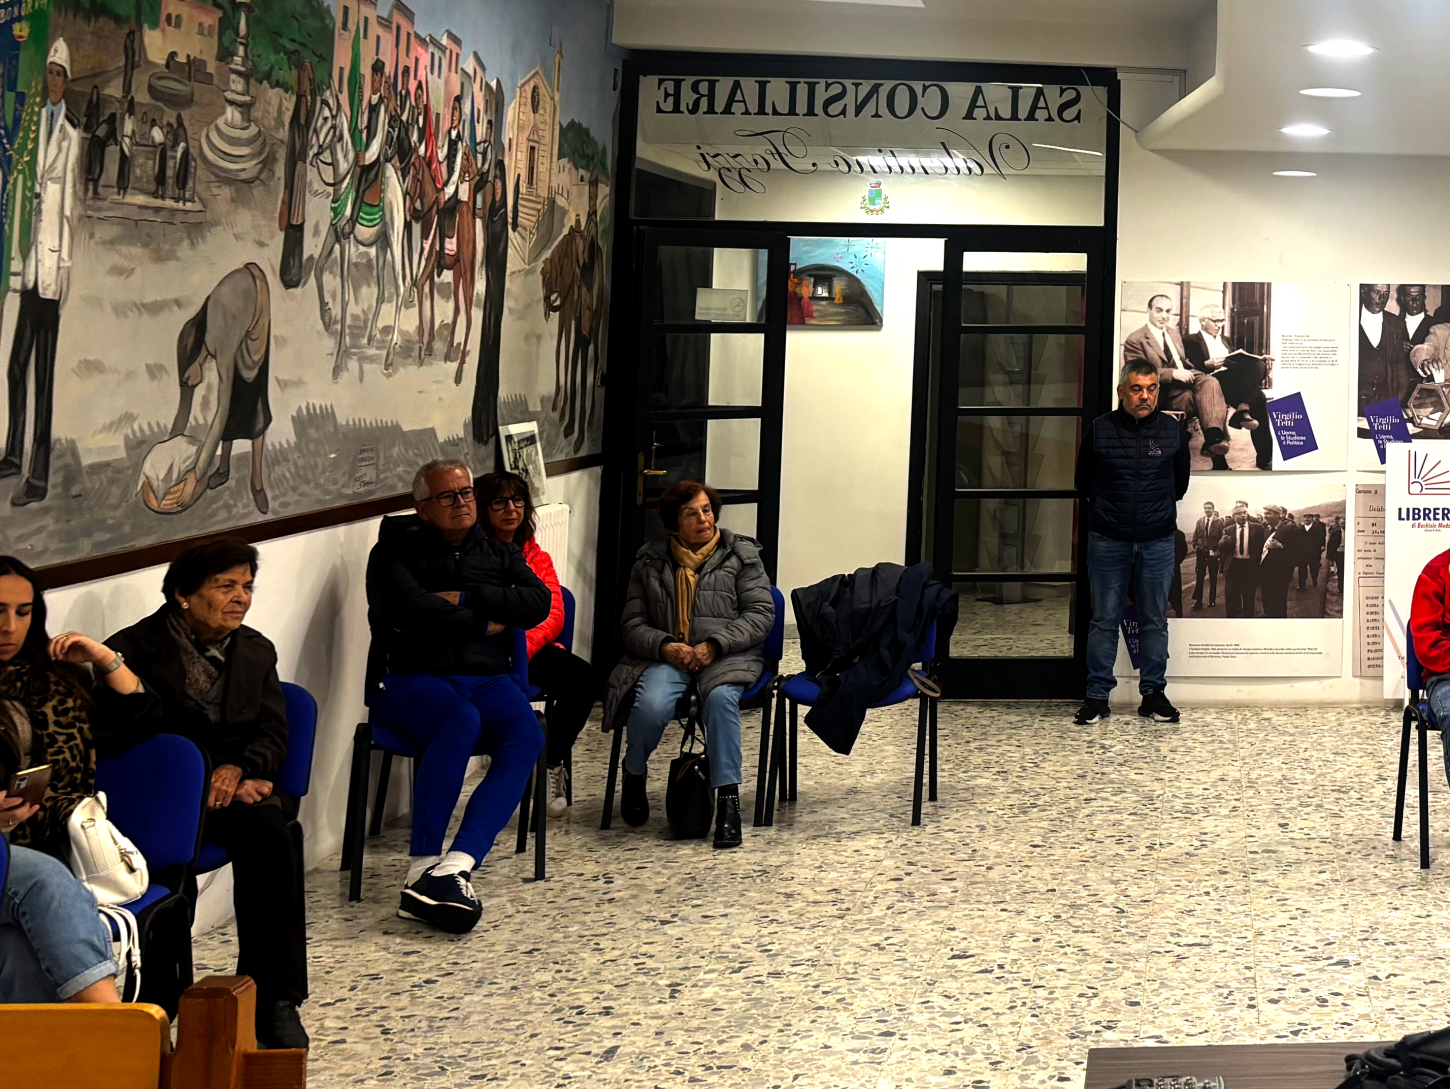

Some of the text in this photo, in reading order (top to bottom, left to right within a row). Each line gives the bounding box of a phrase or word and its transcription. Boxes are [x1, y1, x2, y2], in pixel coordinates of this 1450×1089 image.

[1272, 411, 1303, 420] Virgilio
[1370, 415, 1400, 424] Virgilio
[1275, 419, 1294, 427] Tetti
[1373, 423, 1391, 431] Tetti
